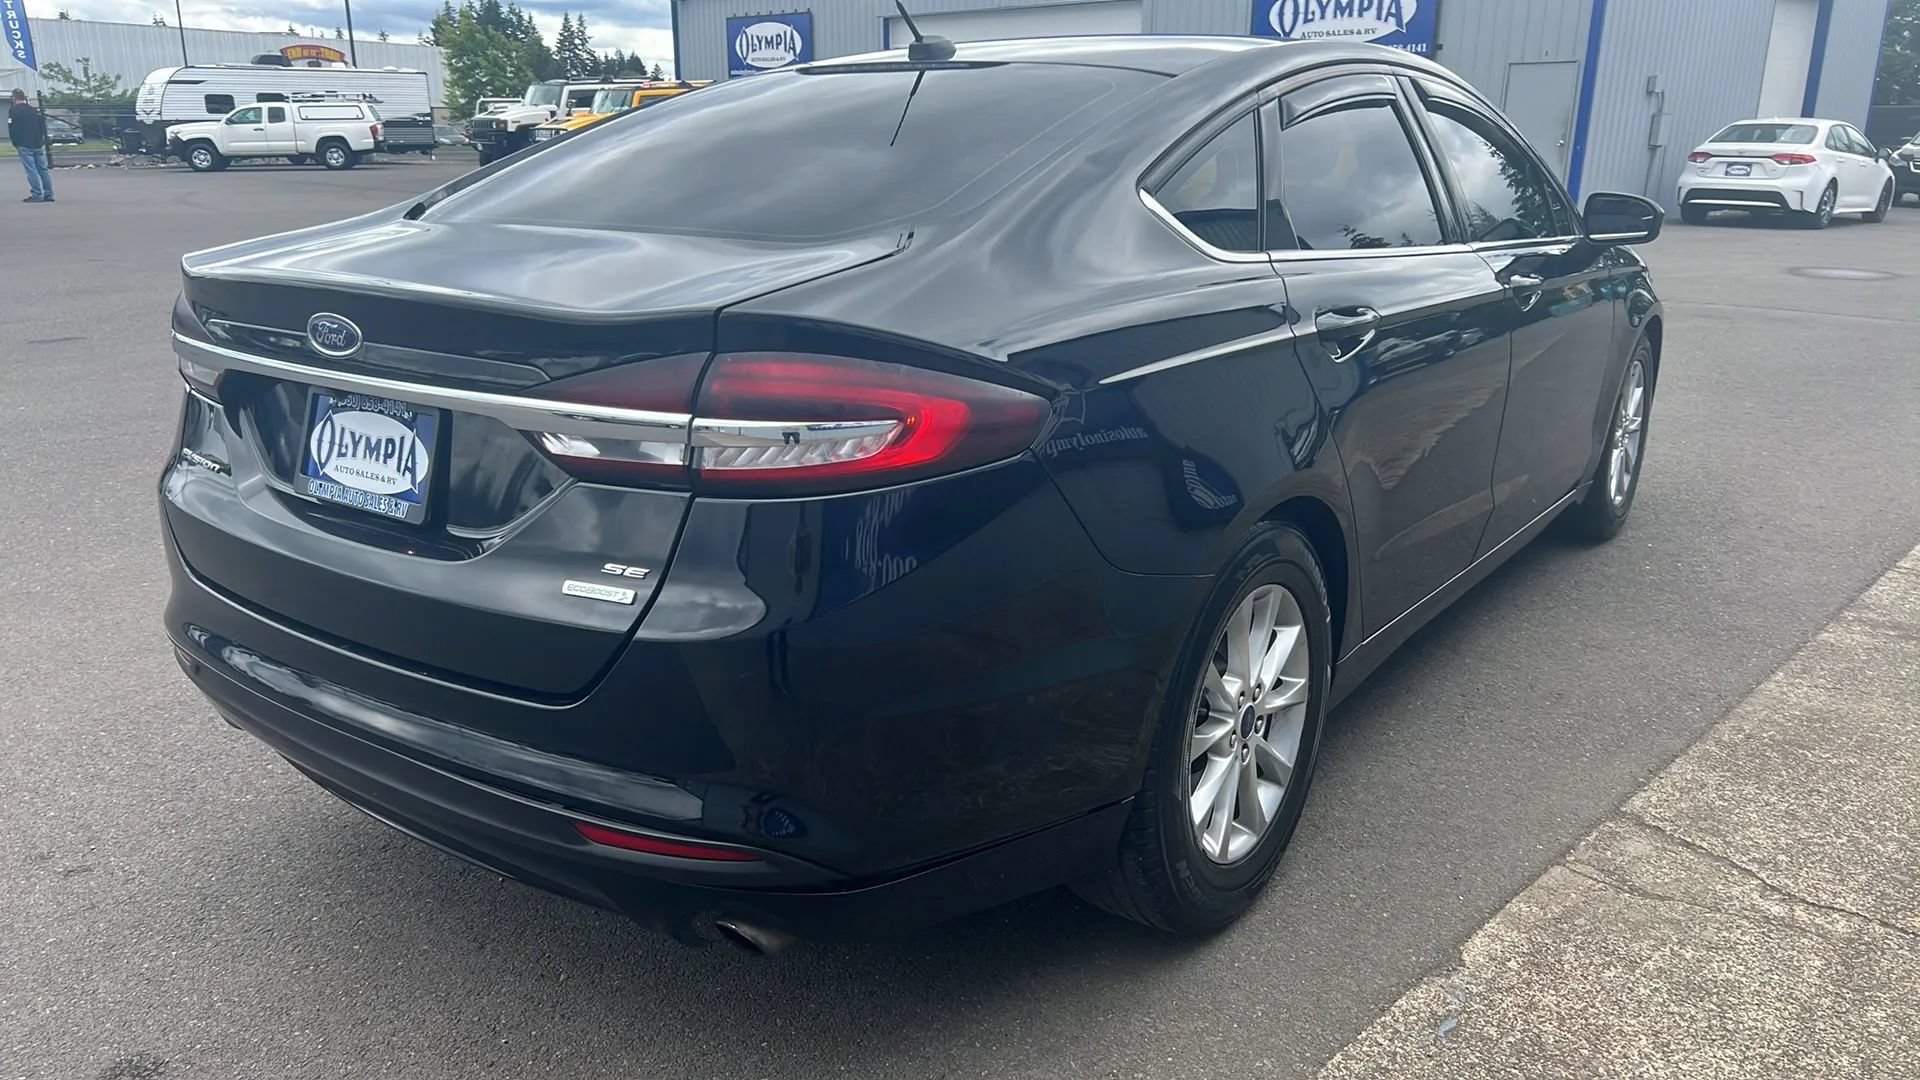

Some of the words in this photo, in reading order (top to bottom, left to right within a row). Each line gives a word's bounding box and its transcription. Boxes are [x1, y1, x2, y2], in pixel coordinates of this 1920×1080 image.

[740, 25, 799, 65] OLYMPIA
[1301, 31, 1324, 39] AUTO
[1326, 29, 1354, 37] SALES
[316, 321, 347, 347] Ford
[317, 409, 418, 494] OLYMPIA
[334, 465, 355, 476] AUTO
[355, 467, 380, 482] SALES
[381, 475, 386, 483] &
[386, 475, 398, 485] RV
[343, 487, 365, 507] AUTO
[364, 492, 388, 513] SALES
[601, 563, 651, 579] SE
